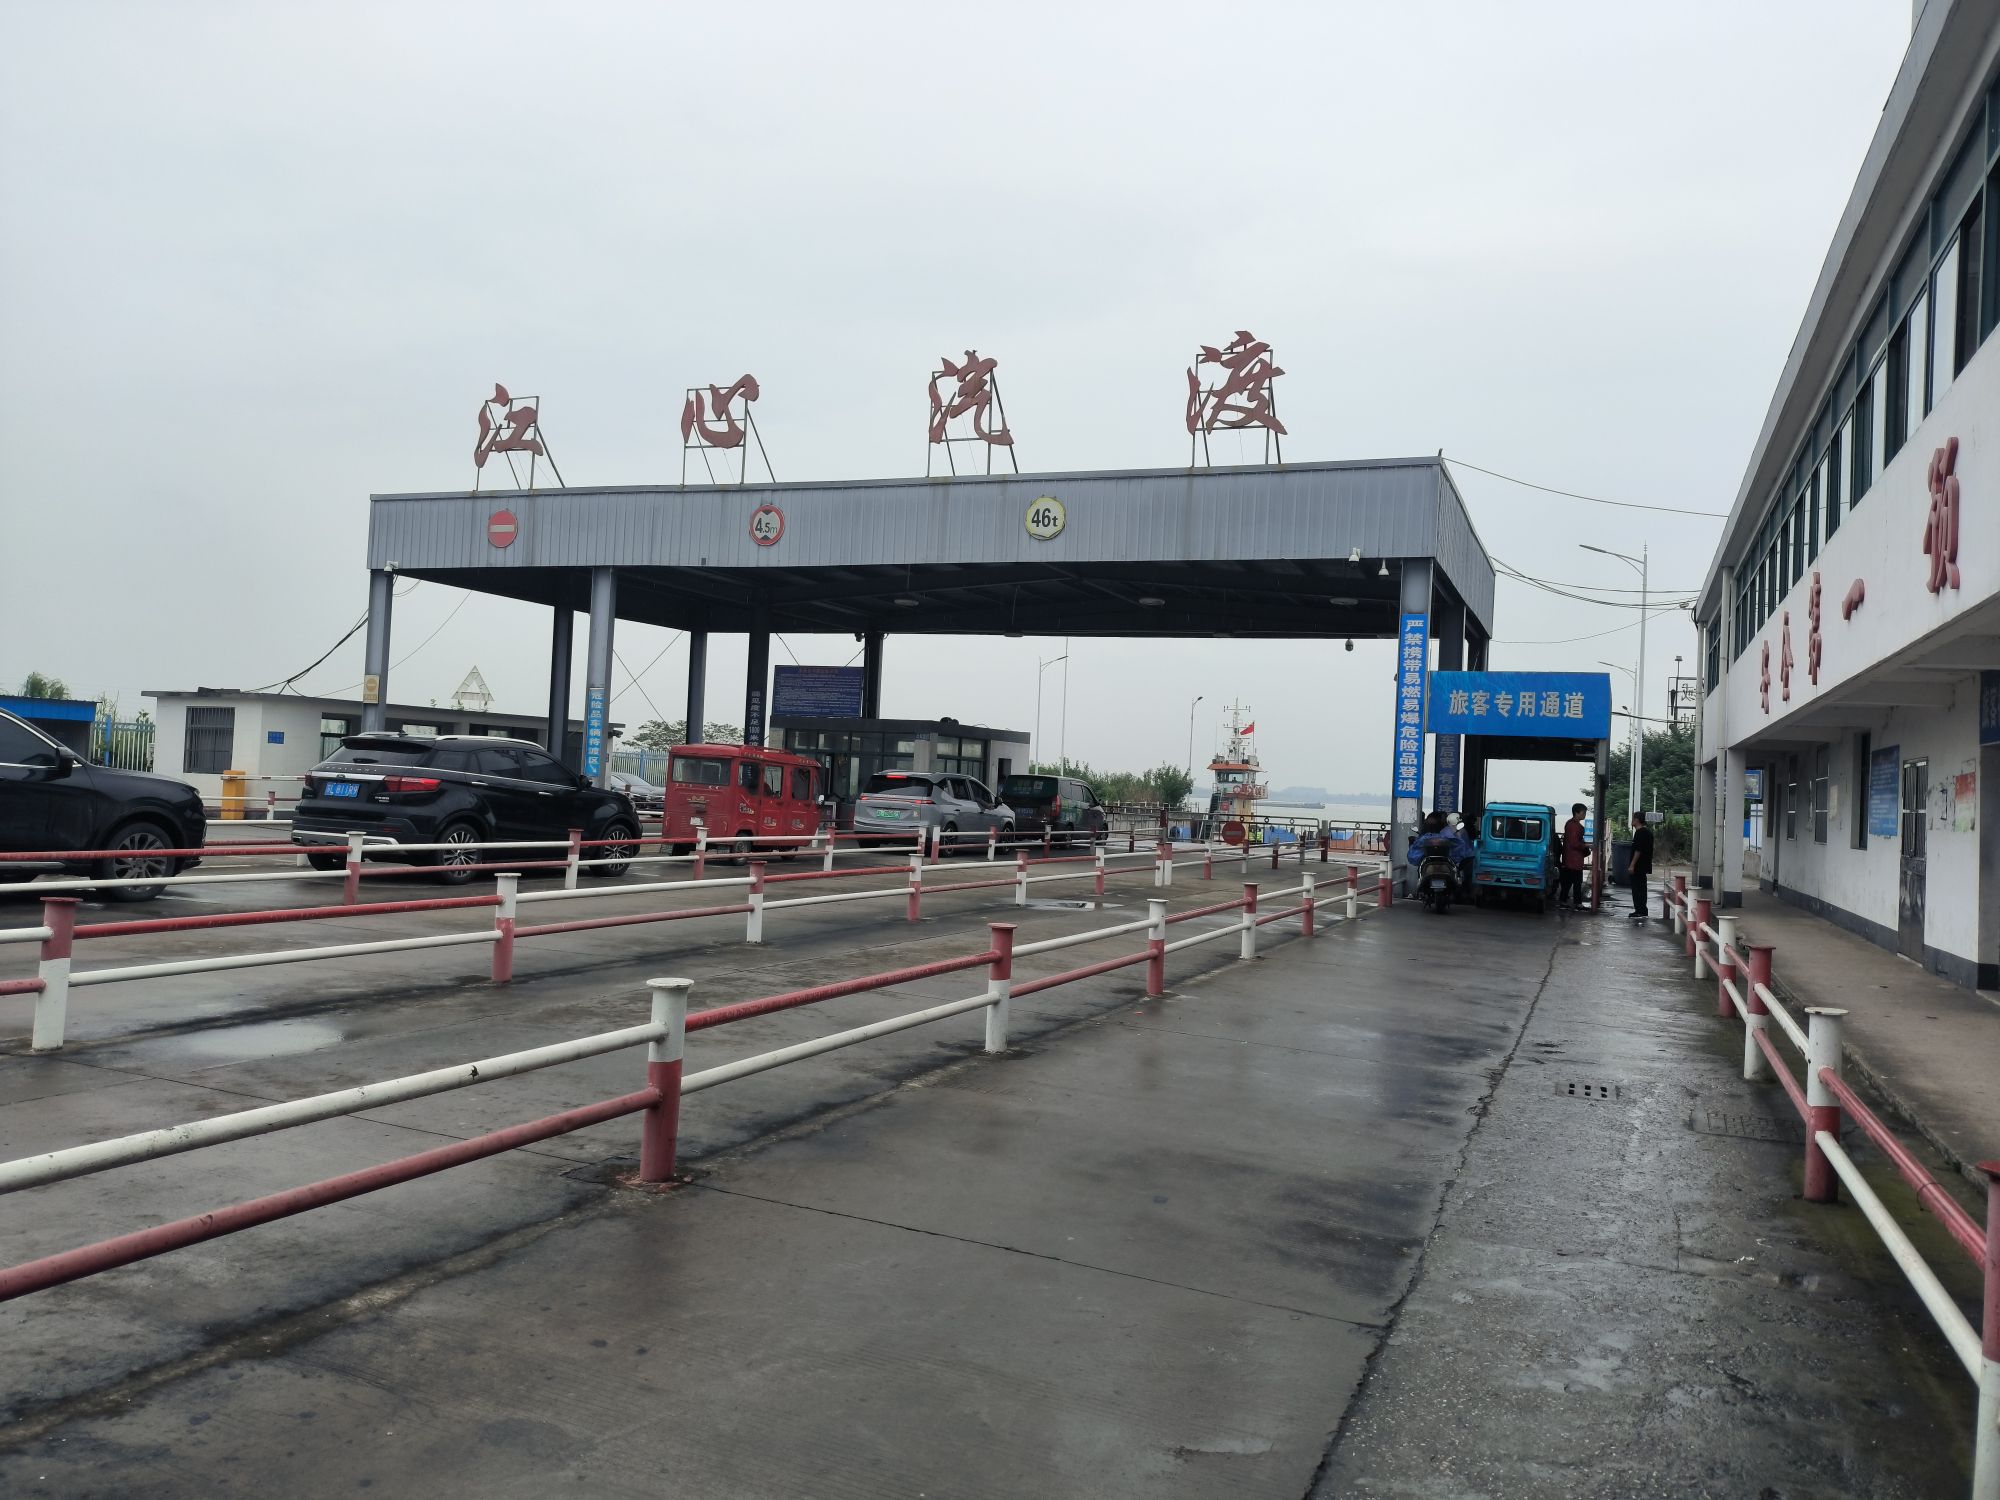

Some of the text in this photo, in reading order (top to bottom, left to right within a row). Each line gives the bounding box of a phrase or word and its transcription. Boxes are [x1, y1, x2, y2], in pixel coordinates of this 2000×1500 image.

[755, 517, 778, 535] 4.5m
[1031, 508, 1058, 528] 46t
[1398, 619, 1424, 792] 严禁携带易燃易爆危险品登渡
[1449, 690, 1585, 719] 旅客专用通道
